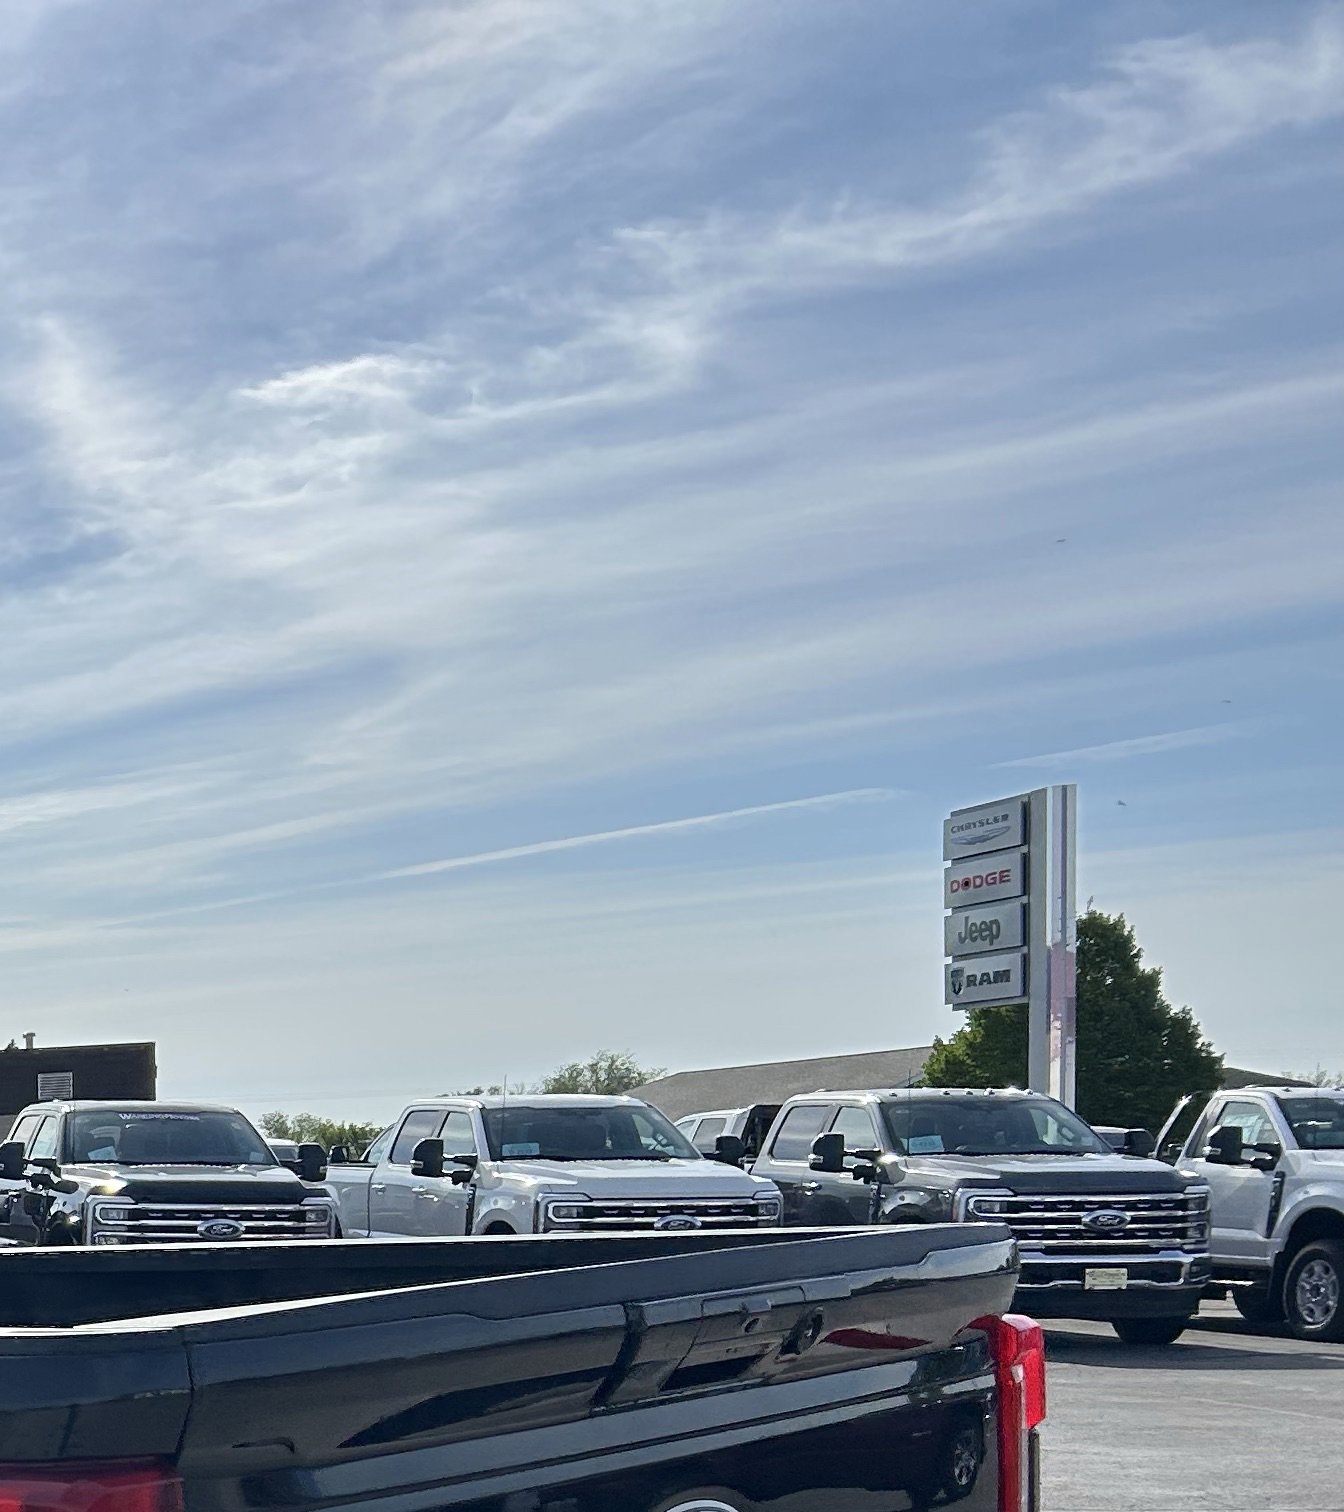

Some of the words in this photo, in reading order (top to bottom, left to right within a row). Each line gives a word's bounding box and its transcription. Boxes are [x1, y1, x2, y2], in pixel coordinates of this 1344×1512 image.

[950, 813, 1009, 834] CHRYSLER
[950, 868, 1012, 894] DODGE
[958, 916, 1001, 946] Jeep
[966, 969, 1011, 988] RAM
